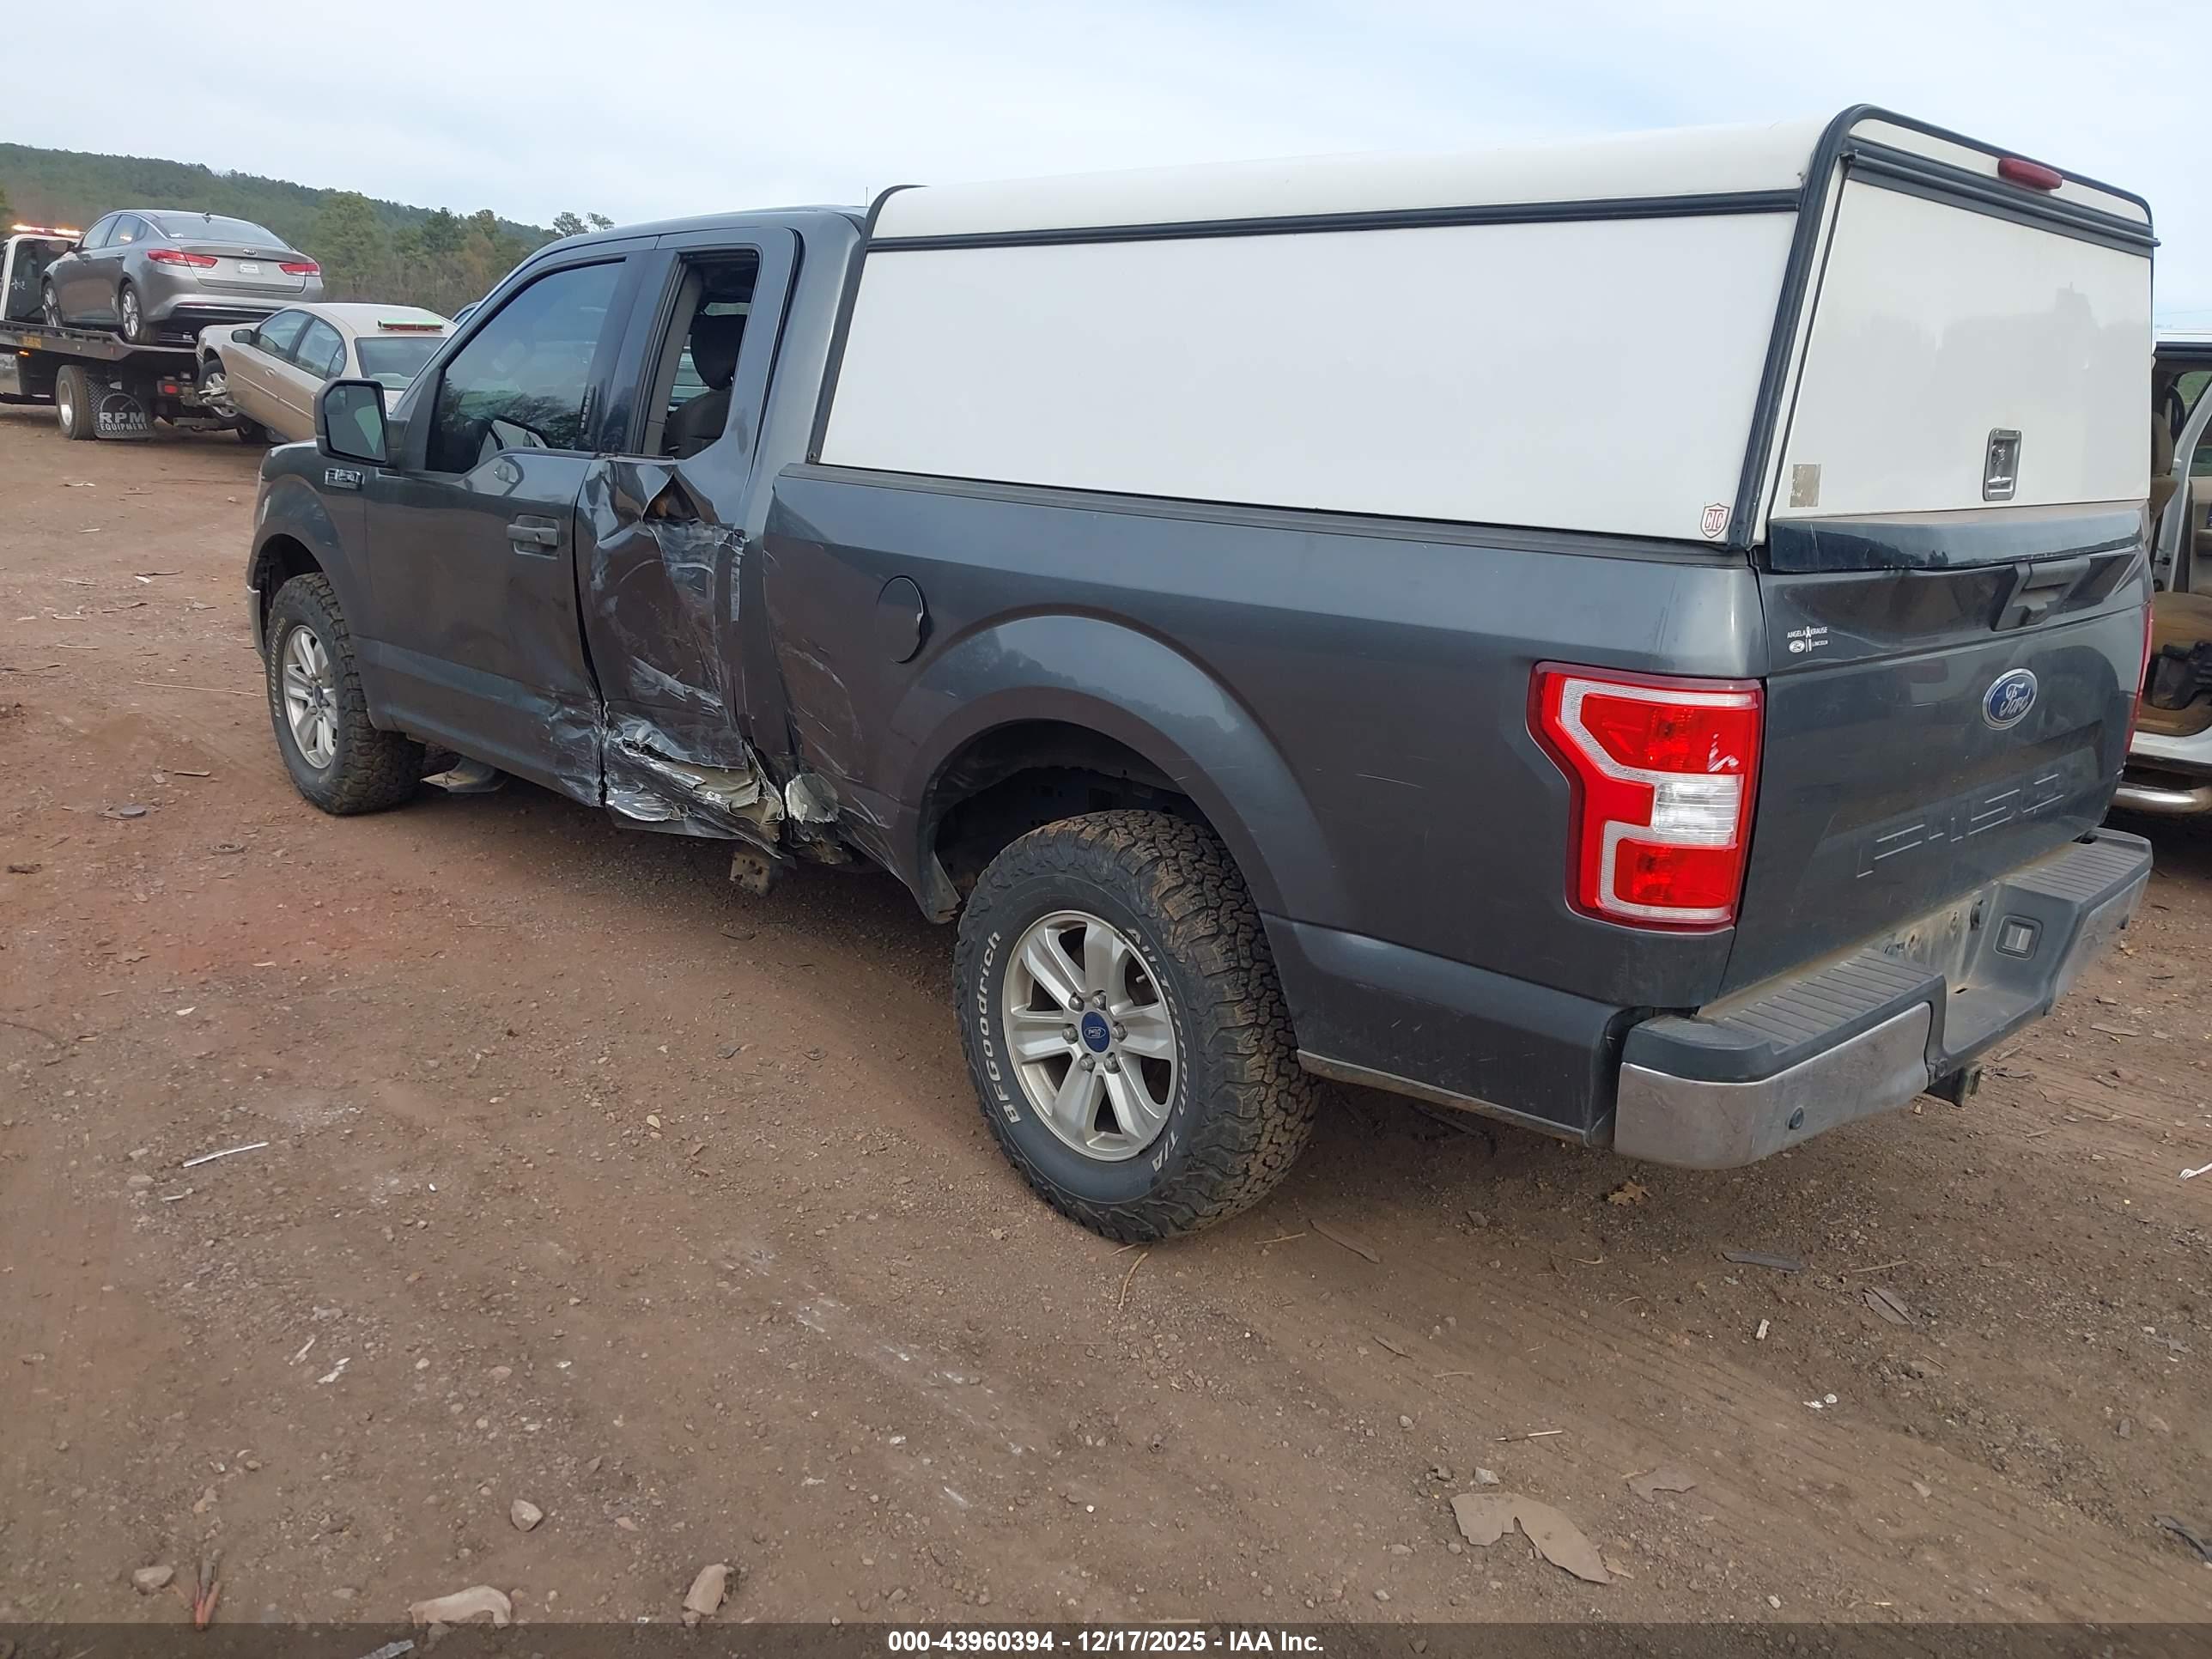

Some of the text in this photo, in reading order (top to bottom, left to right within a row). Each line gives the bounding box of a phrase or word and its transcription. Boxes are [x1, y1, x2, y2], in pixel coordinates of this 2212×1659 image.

[99, 412, 145, 423] RPM
[100, 422, 148, 431] EQUIPMENT
[1787, 627, 1828, 638] ANGELA KRAUSE
[1998, 682, 2031, 717] Ford
[976, 931, 1022, 1124] BFGoodrich
